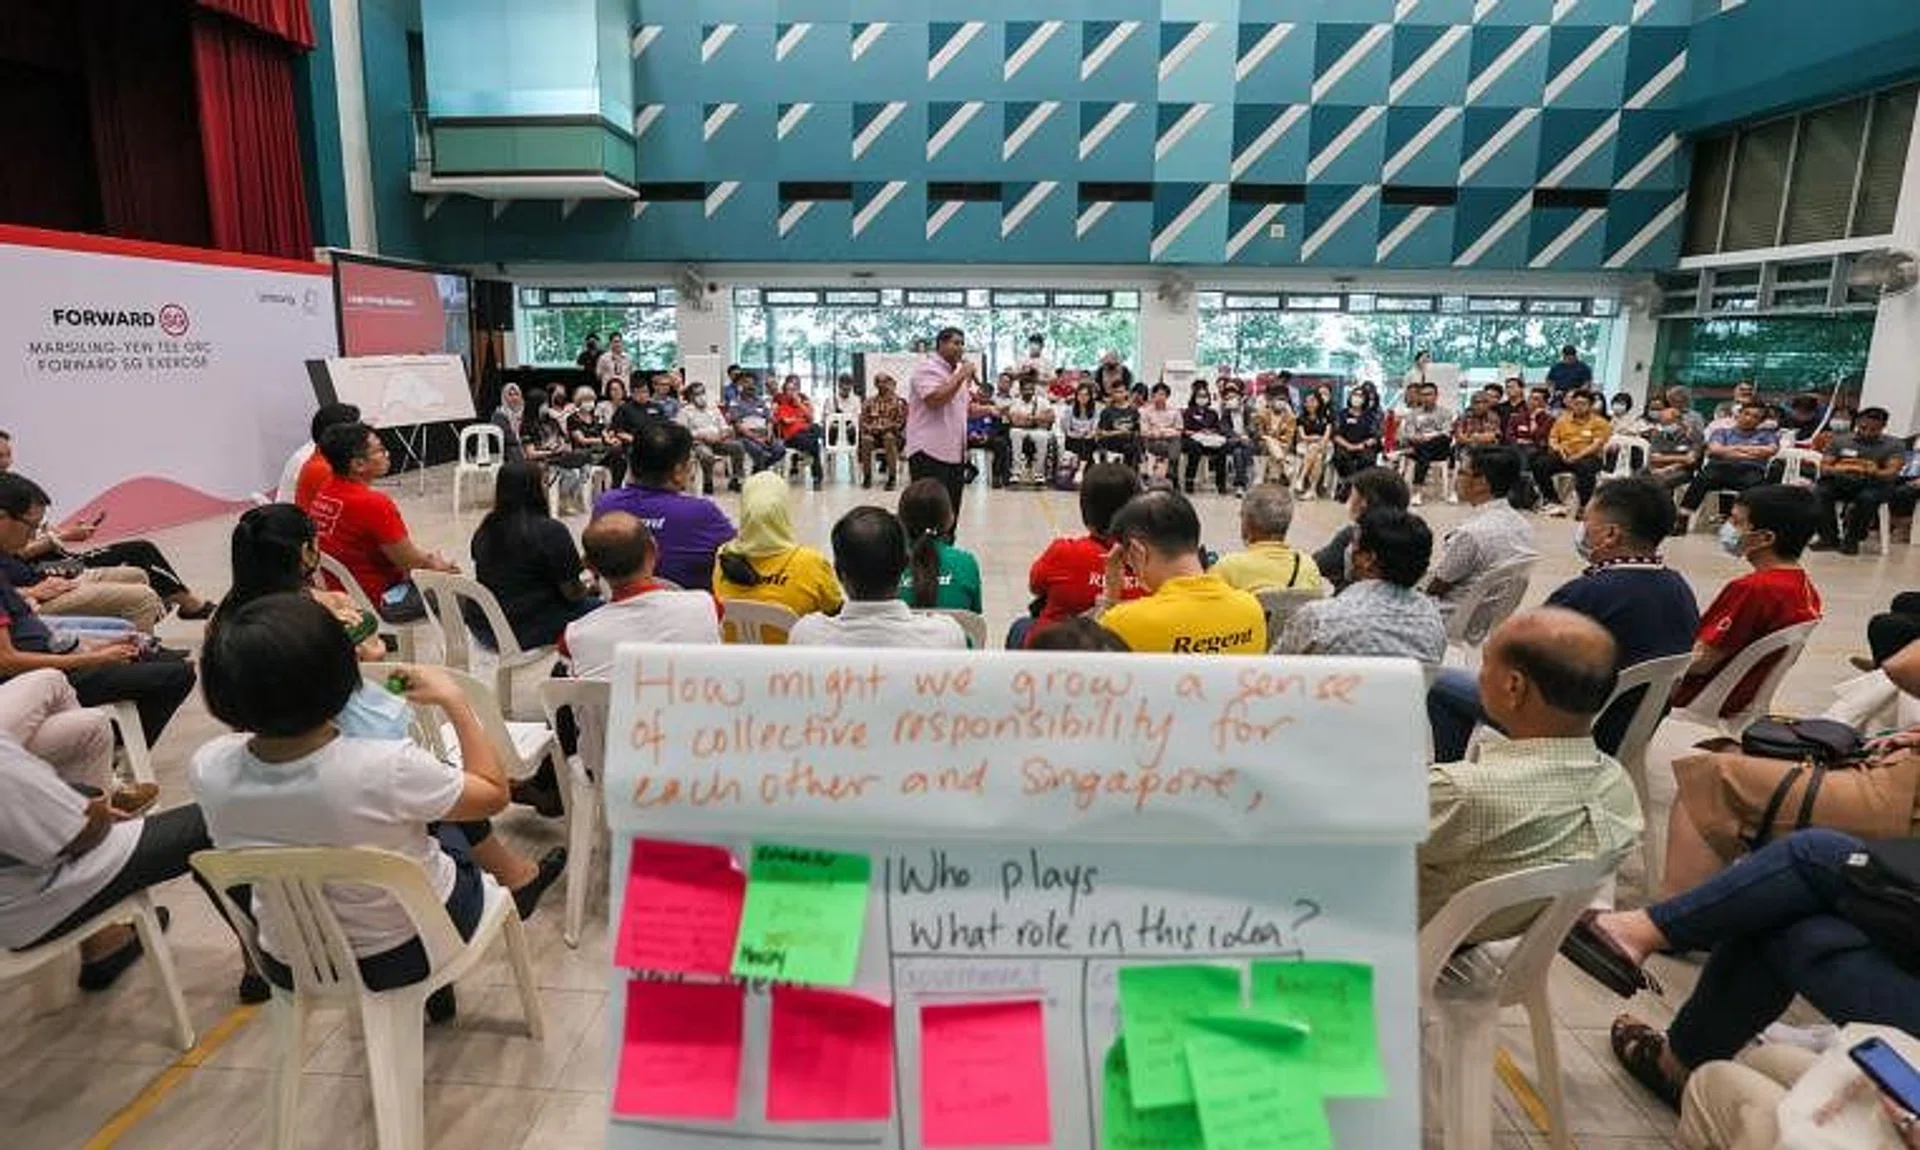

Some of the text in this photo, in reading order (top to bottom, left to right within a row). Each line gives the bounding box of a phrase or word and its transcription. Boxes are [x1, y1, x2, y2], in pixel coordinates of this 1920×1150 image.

[53, 308, 155, 327] FORWARD
[38, 357, 116, 372] FORWARD
[121, 358, 143, 371] SG
[1172, 628, 1254, 654] Regent
[634, 657, 1366, 720] How might we grow a sense
[629, 697, 1297, 769] of collective responsibility for
[630, 754, 1264, 813] each other and Singapore,
[899, 848, 1100, 917] Who plays
[1016, 909, 1071, 950] role
[1088, 919, 1127, 953] in
[1138, 904, 1194, 950] this
